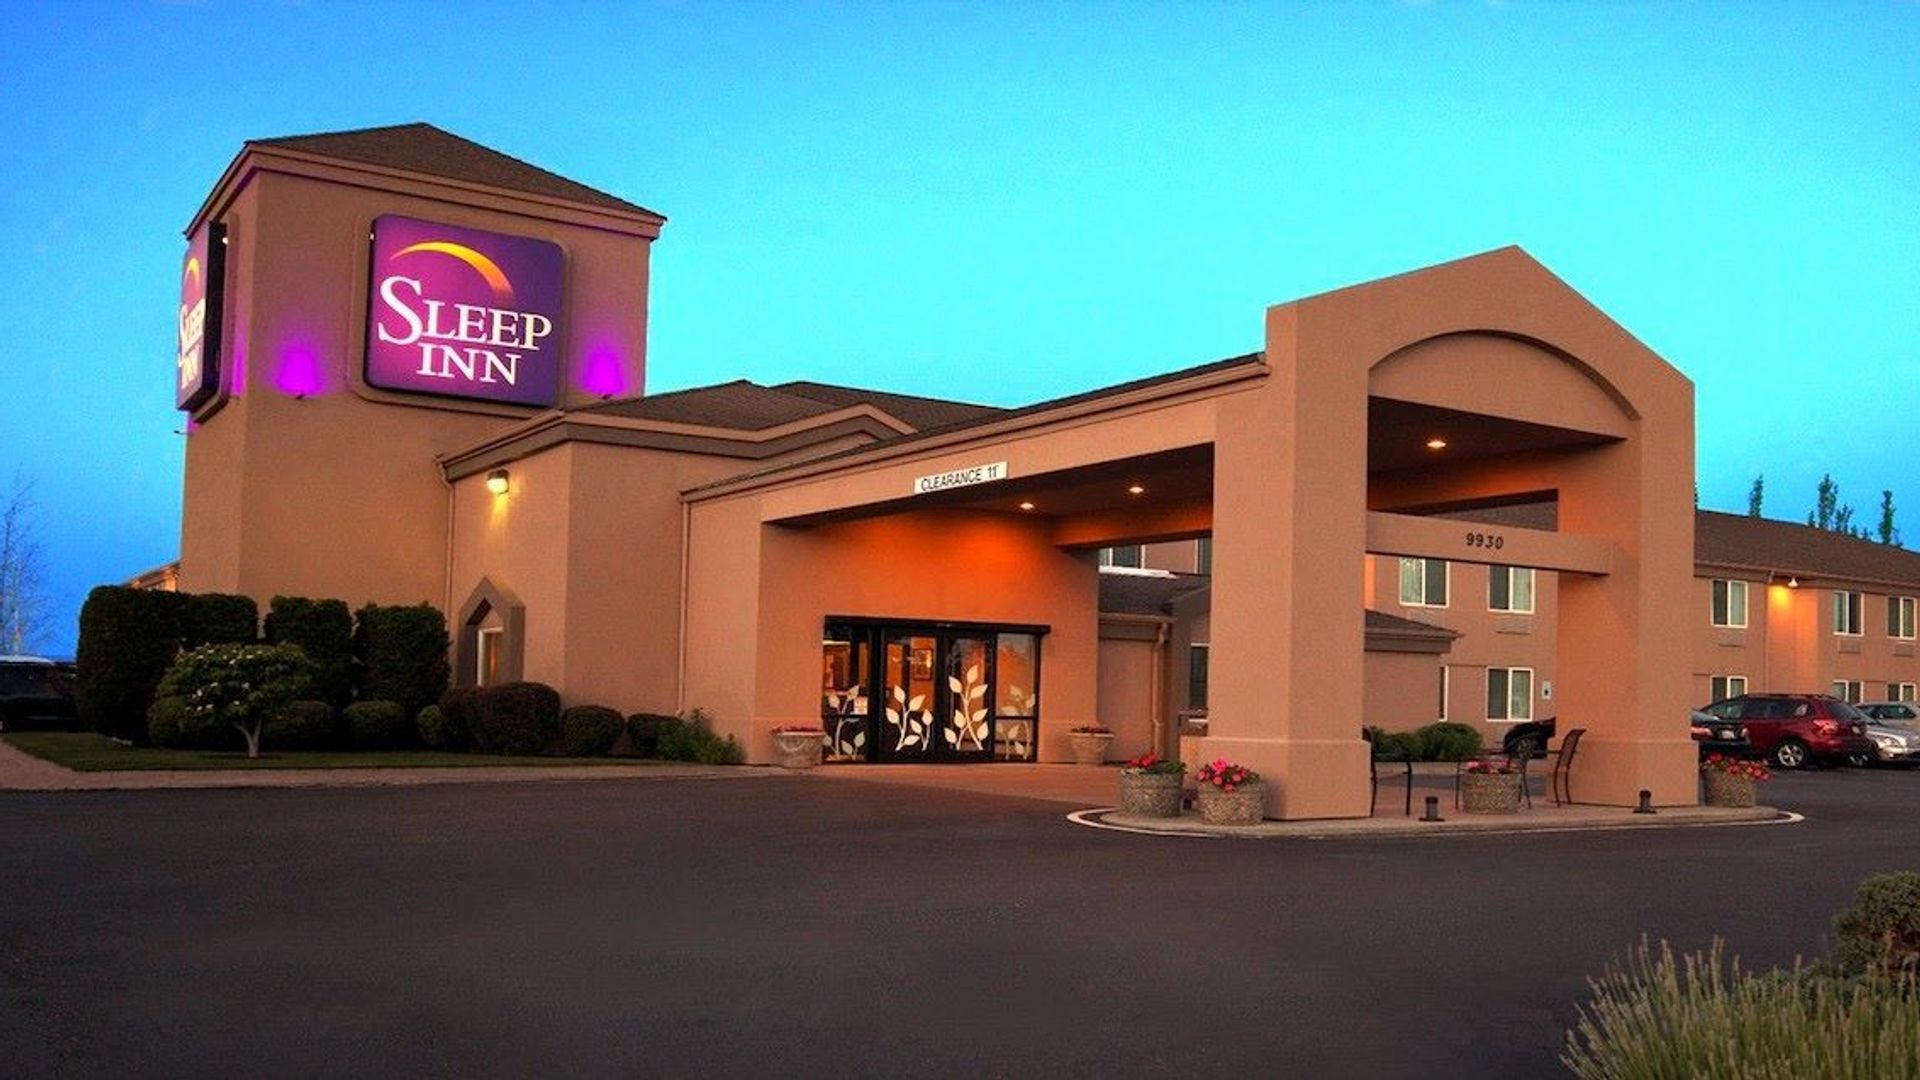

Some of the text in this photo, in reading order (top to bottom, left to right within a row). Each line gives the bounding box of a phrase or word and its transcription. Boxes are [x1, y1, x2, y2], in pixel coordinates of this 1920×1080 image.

[378, 276, 552, 350] SLEEP
[416, 342, 521, 386] INN
[921, 468, 982, 491] CLEARANCE
[1466, 532, 1504, 550] 9930
